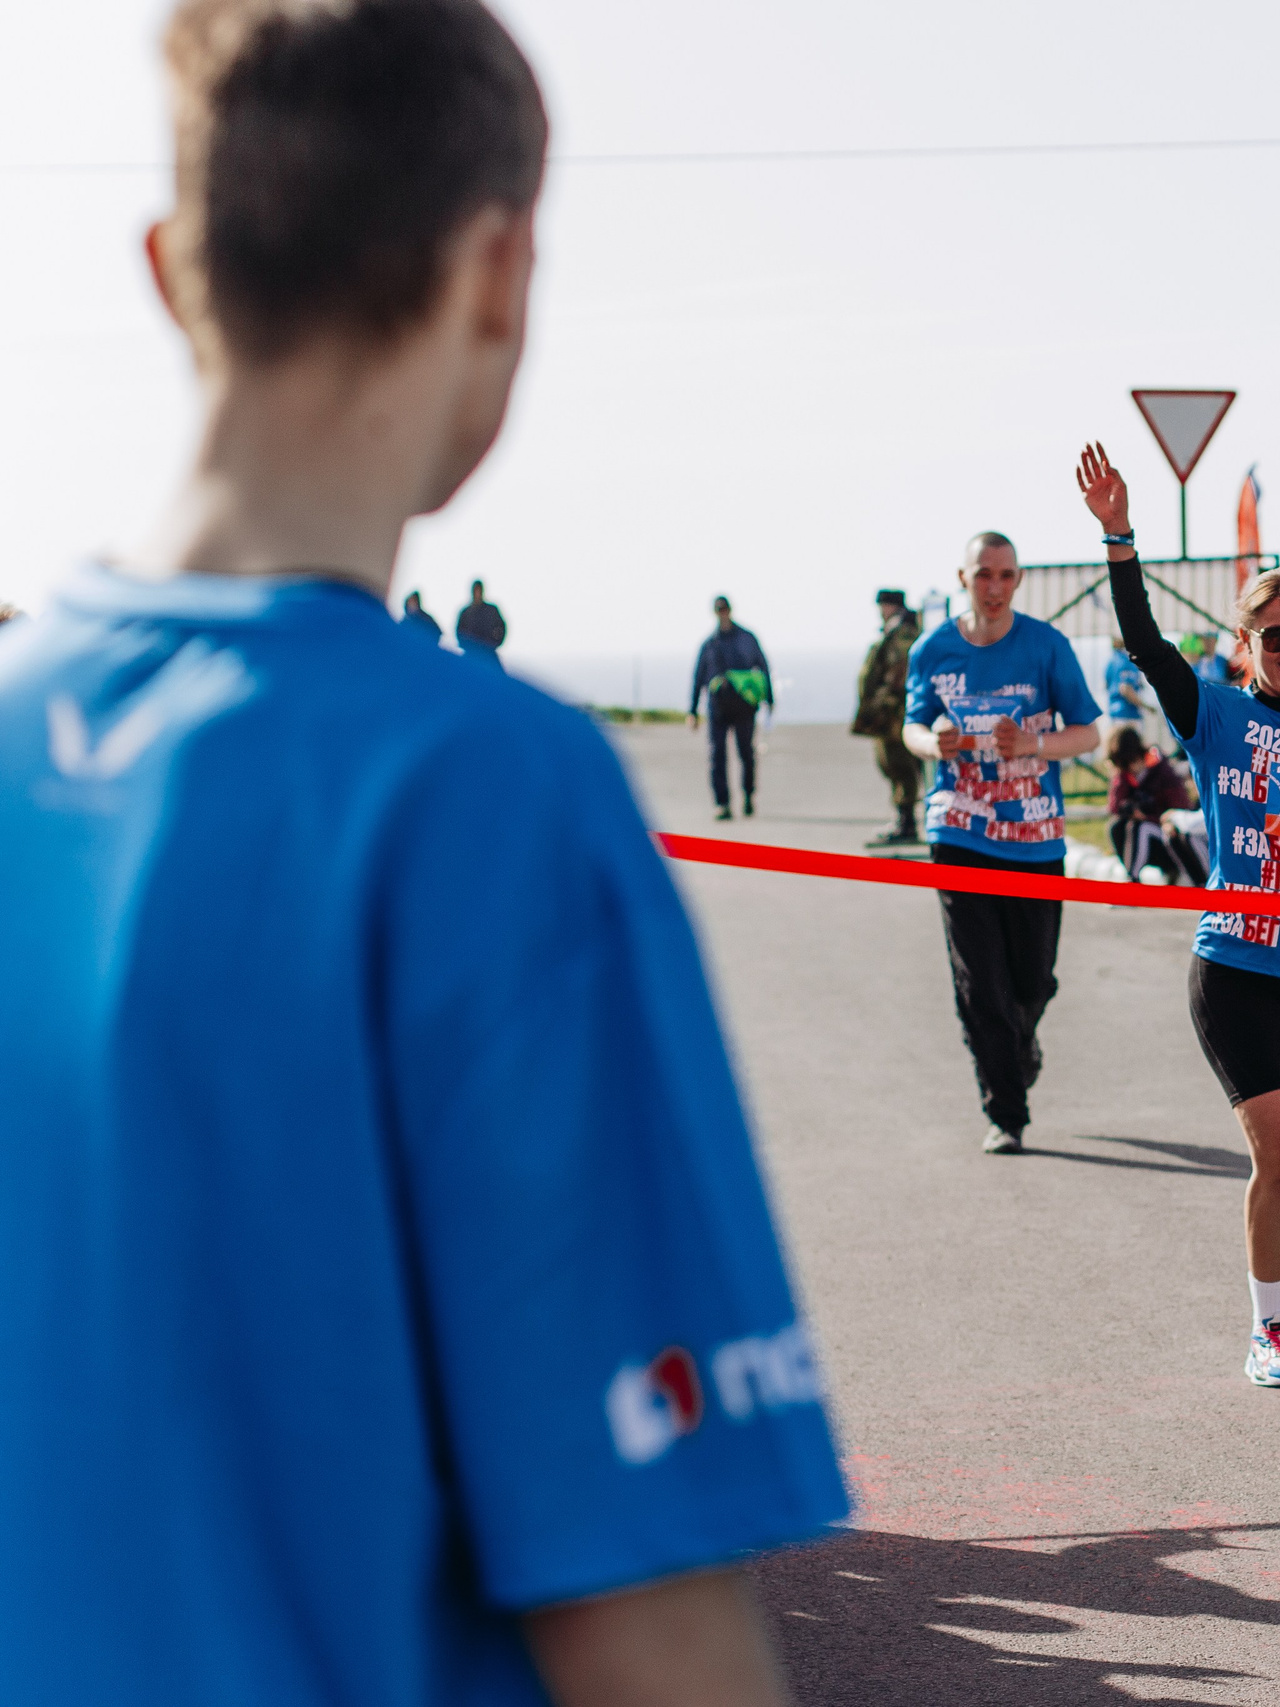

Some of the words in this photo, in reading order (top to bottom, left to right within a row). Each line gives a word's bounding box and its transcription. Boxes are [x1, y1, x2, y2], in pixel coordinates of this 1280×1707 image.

[1218, 766, 1270, 804] #ЗАБ
[1021, 796, 1058, 821] 2024
[1211, 912, 1280, 947] #ЗАБЕГ
